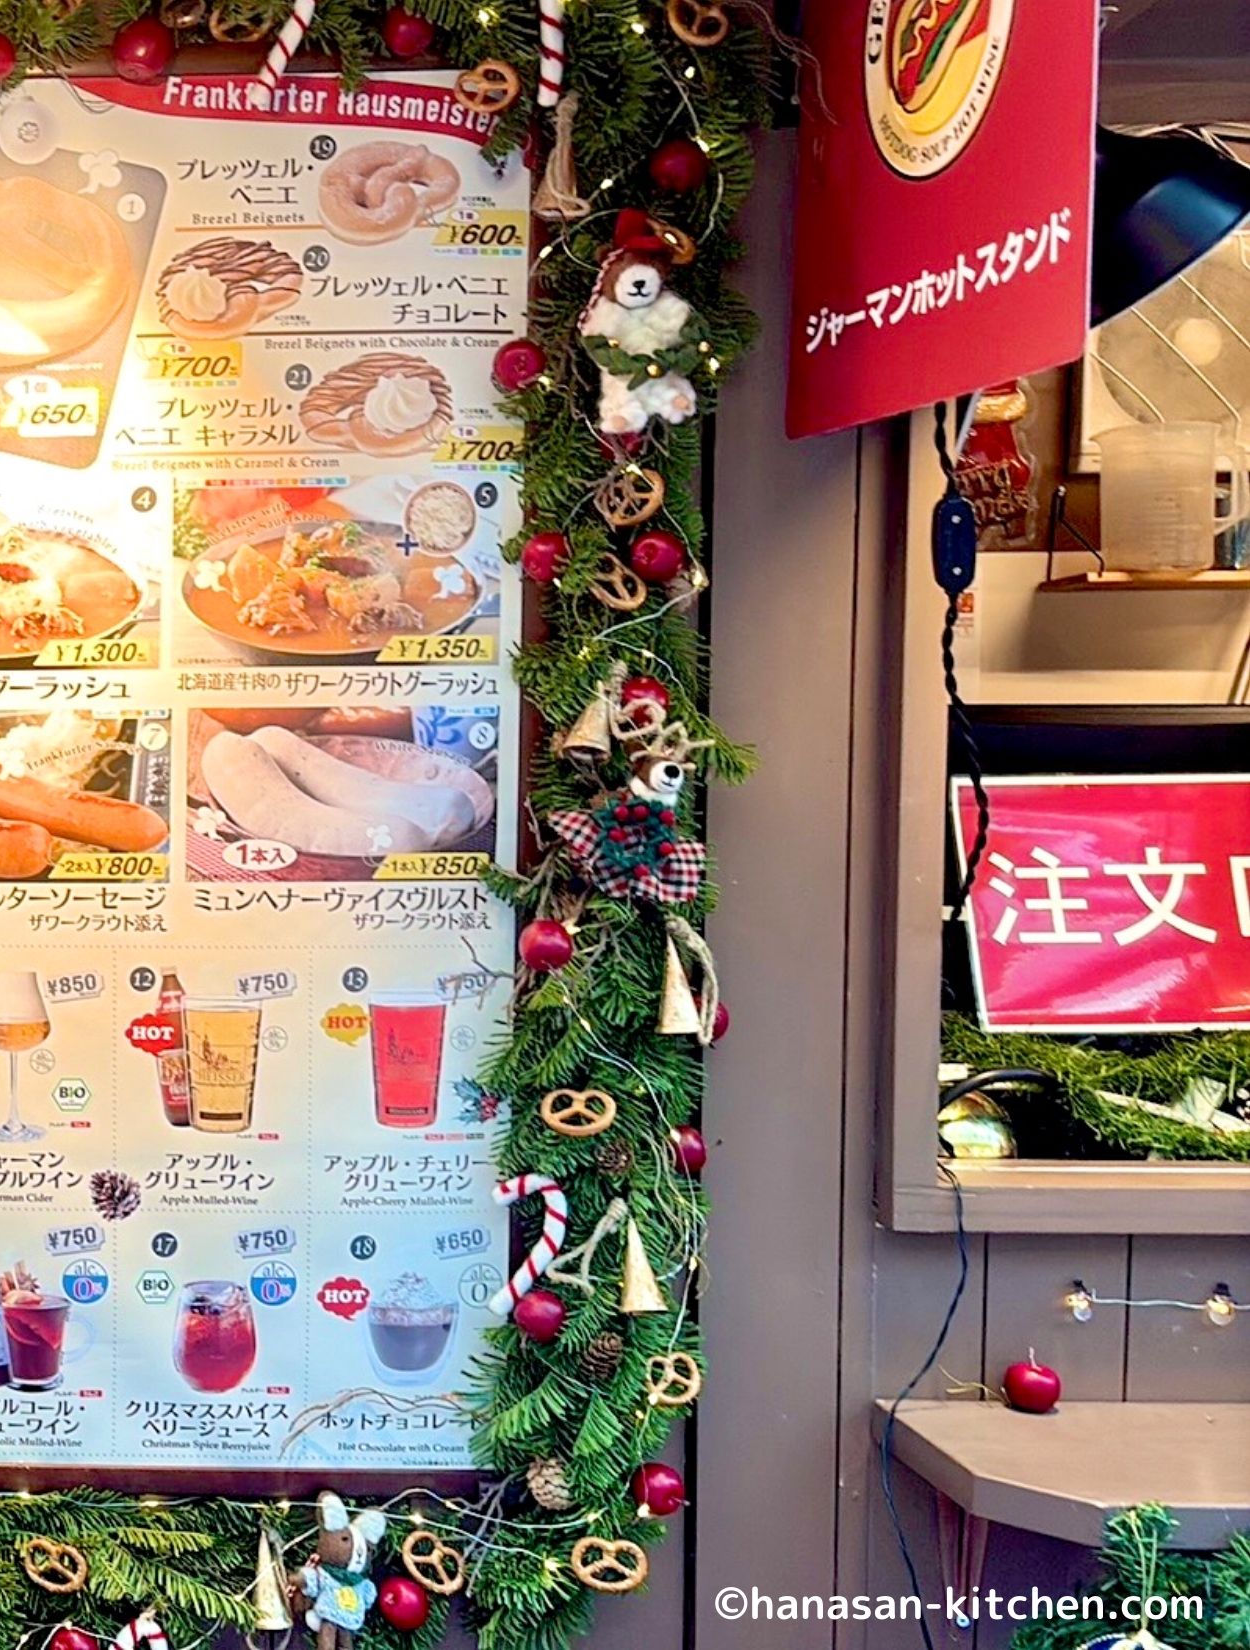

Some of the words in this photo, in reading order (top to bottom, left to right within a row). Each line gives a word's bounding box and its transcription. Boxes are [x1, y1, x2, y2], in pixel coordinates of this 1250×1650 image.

[313, 139, 333, 157] 19
[230, 186, 299, 205] ベニエ
[192, 212, 237, 225] Brezel
[242, 211, 305, 228] Beignets
[449, 224, 517, 246] ¥600
[306, 251, 328, 269] 20
[310, 277, 510, 298] プレッツェル・ベニエ
[806, 206, 1072, 354] ジャーマンホットスタンド
[392, 303, 509, 326] チョコレート
[264, 337, 302, 350] Brezel
[305, 337, 355, 352] Beignets
[359, 337, 386, 349] with
[389, 336, 447, 349] Chocolate
[451, 338, 460, 349] &
[464, 338, 500, 349] Cream
[158, 355, 232, 378] ¥700
[289, 369, 309, 386] 21
[115, 427, 182, 446] ベニエ
[195, 425, 301, 447] キャラメル
[152, 459, 200, 471] Beignets
[204, 458, 231, 469] with
[235, 457, 283, 468] Caramel
[288, 457, 297, 468] &
[303, 457, 340, 468] Cream
[134, 491, 152, 509] 4
[480, 487, 492, 504] 5
[57, 642, 136, 663] ¥1,300
[397, 639, 480, 659] ¥1,350
[178, 673, 280, 691] 北海道産牛肉の
[285, 672, 499, 696] ザワークラウトグーラッシュ
[148, 728, 161, 745] 7
[477, 726, 488, 745] 8
[235, 844, 287, 865] 1本入
[95, 856, 152, 877] ¥800
[419, 856, 478, 875] ¥850
[193, 888, 488, 912] ミュンヘナーヴァイスヴルスト
[987, 846, 1250, 947] 注文
[29, 913, 167, 932] ザワークラウト添え
[352, 913, 492, 931] ザワークラウト添え
[47, 974, 97, 996] ¥850
[134, 972, 151, 987] 12
[238, 973, 289, 995] ¥750
[326, 1015, 367, 1029] HOT
[130, 1026, 174, 1041] HOT
[166, 1155, 252, 1171] アップル・
[323, 1154, 490, 1172] アップル・チェリー
[146, 1173, 275, 1191] グリューワイン
[344, 1175, 473, 1193] グリューワイン
[27, 1193, 54, 1203] Cider
[161, 1195, 189, 1206] Apple
[192, 1195, 258, 1205] Mulled-Wine
[340, 1196, 407, 1207] Apple-Cherry
[409, 1196, 474, 1205] Mulled-Wine
[48, 1227, 97, 1249] ¥750
[156, 1237, 174, 1252] 17
[238, 1228, 287, 1251] ¥750
[355, 1238, 374, 1256] 18
[436, 1230, 483, 1252] ¥650
[324, 1290, 367, 1303] HOT
[126, 1402, 288, 1419] クリスマススパイス
[143, 1420, 271, 1438] ベリージュース
[18, 1437, 83, 1447] Mulled-Wine
[142, 1438, 190, 1448] Christmas
[193, 1439, 218, 1450] Spice
[338, 1442, 356, 1451] Hot
[358, 1442, 406, 1452] Chocolate
[408, 1442, 431, 1451] with
[433, 1443, 465, 1452] Cream
